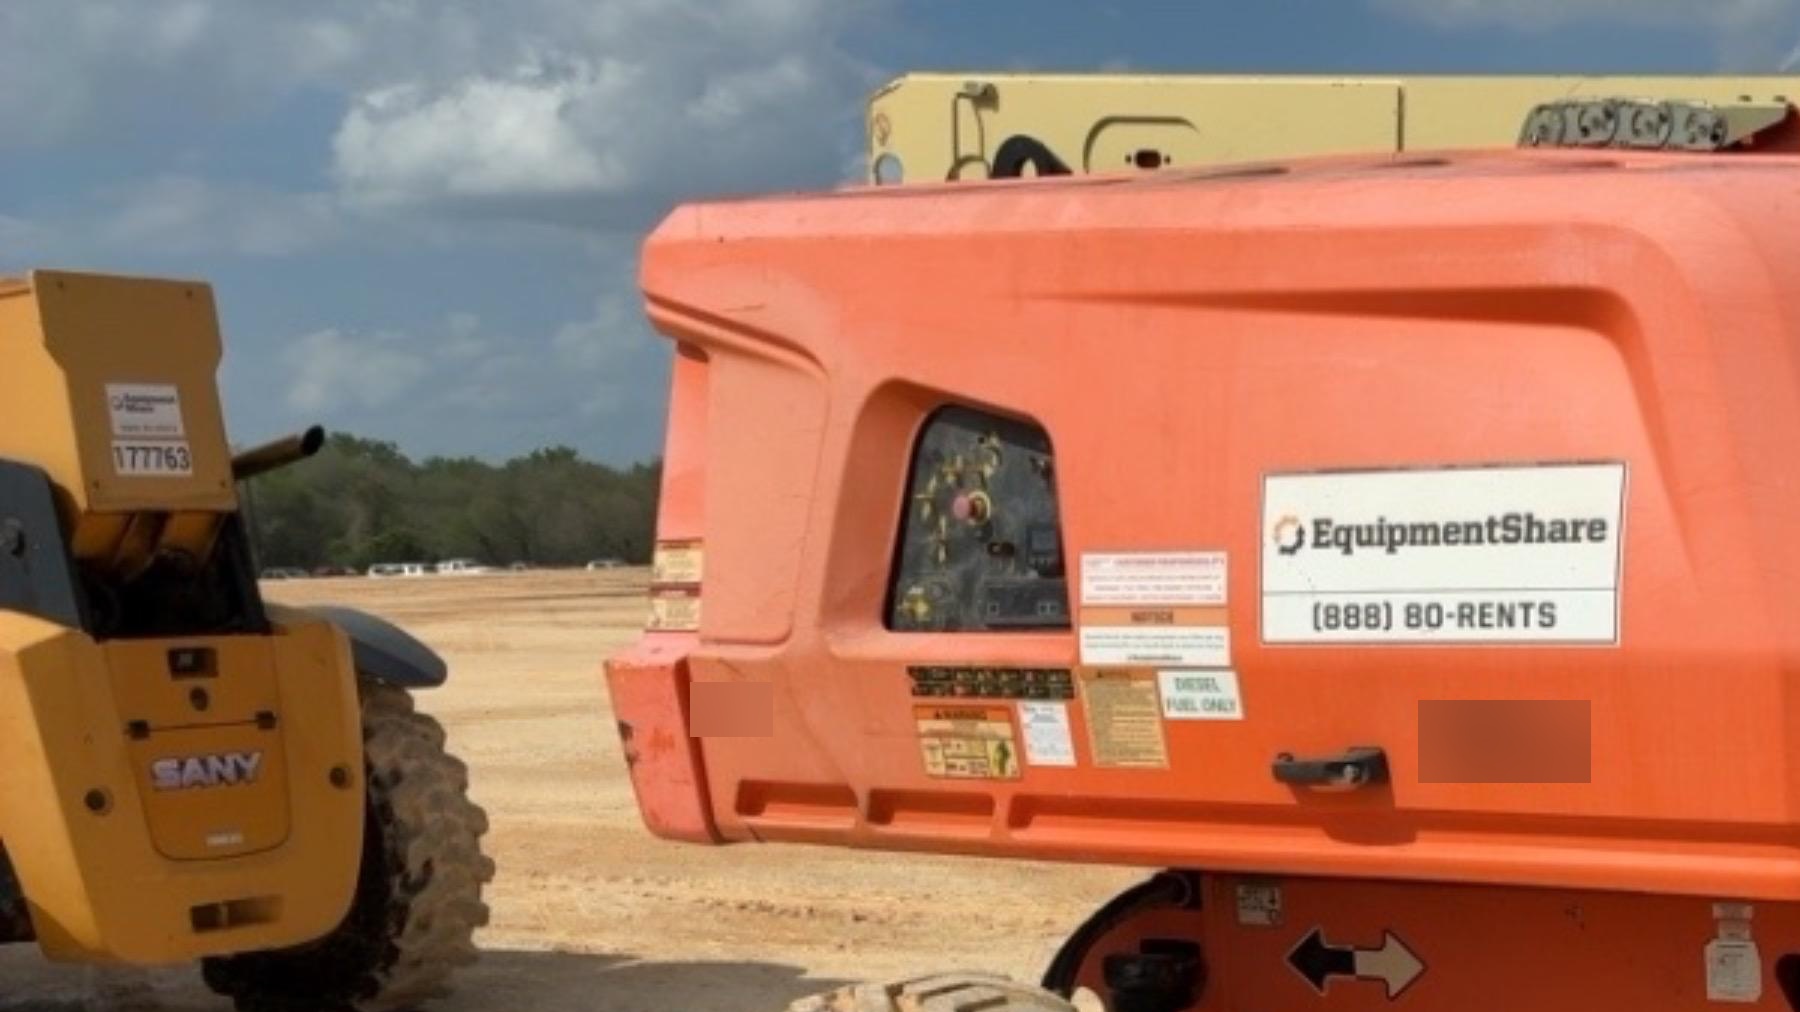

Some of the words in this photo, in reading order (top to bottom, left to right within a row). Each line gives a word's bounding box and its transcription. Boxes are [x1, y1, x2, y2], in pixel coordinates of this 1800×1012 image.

[112, 446, 190, 470] 177763
[1311, 513, 1608, 555] EquipmentShare
[1312, 600, 1393, 631] (888)
[1404, 602, 1557, 630] 80-RENTS
[1174, 677, 1221, 693] DIESEL
[1167, 698, 1199, 712] FUEL
[151, 752, 261, 790] SANY
